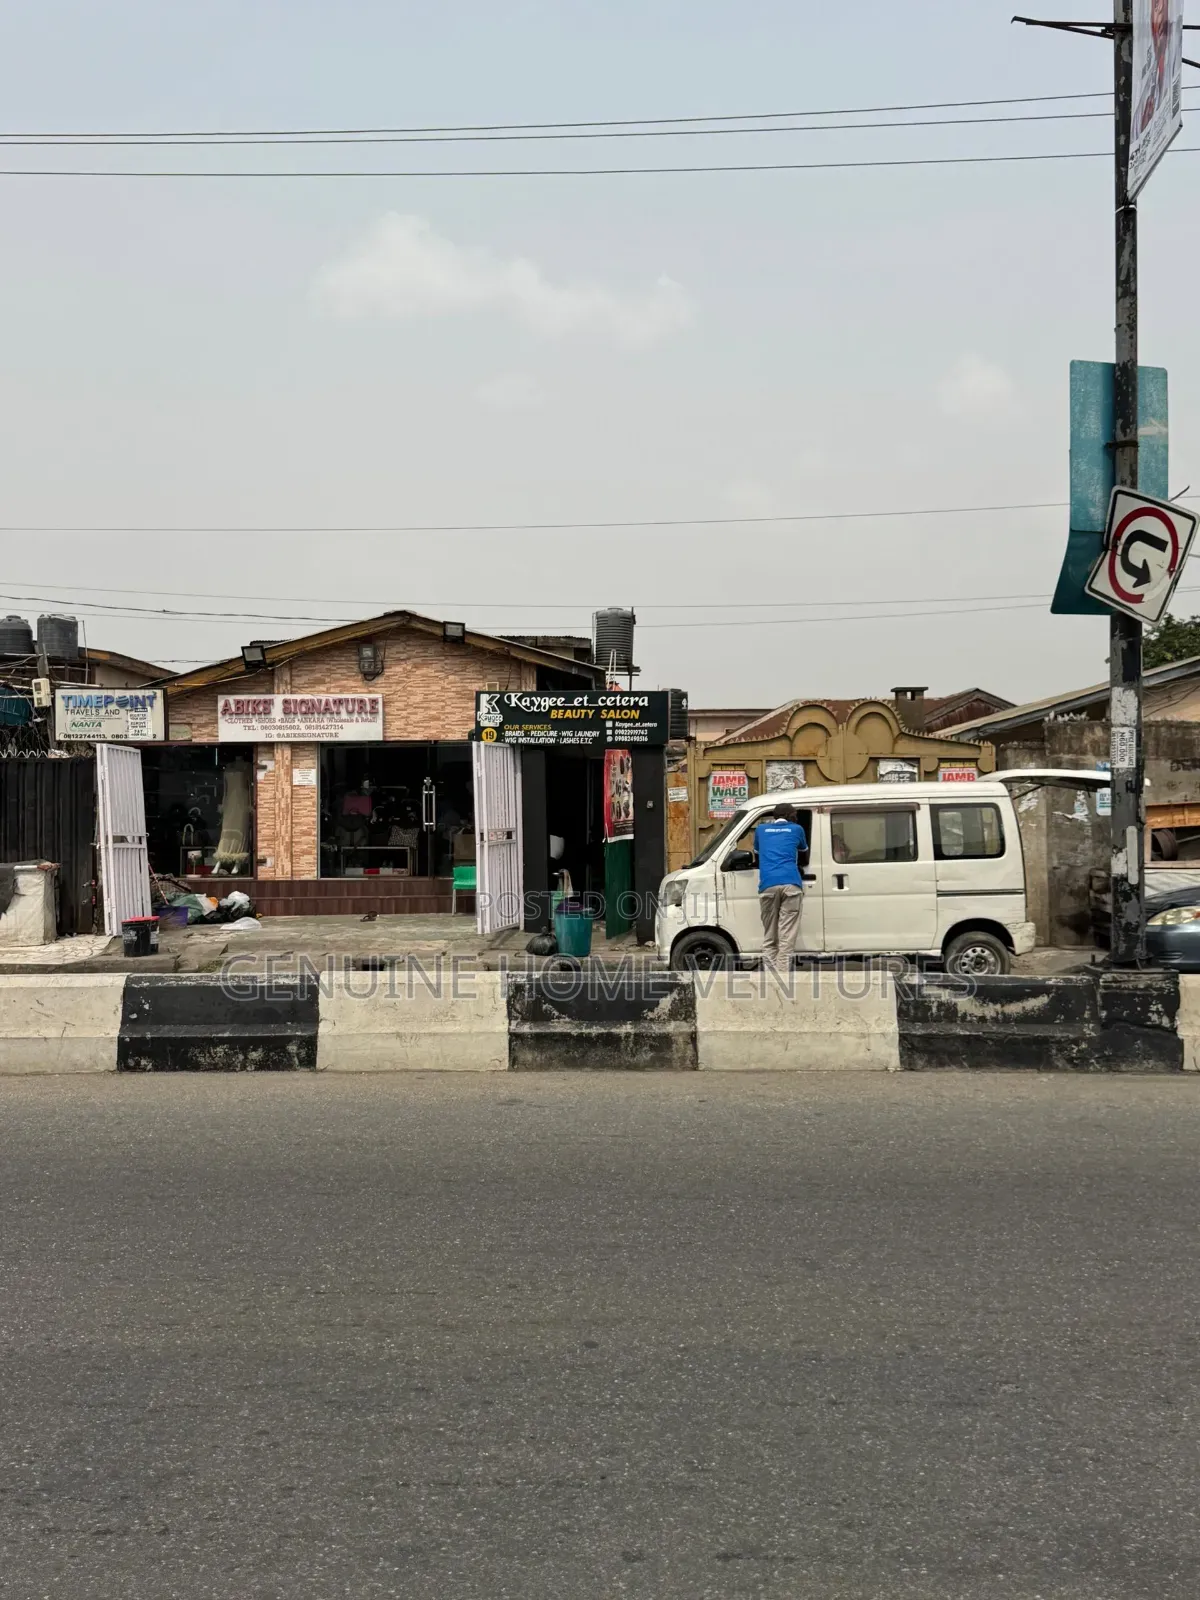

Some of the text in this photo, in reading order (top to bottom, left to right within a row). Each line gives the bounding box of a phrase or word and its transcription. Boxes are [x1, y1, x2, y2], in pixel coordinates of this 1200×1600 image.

[61, 694, 157, 709] TIMEPOINT
[282, 697, 379, 715] SIGNATURE
[504, 692, 649, 712] Kaygee_et_cetera
[550, 709, 640, 719] BEAUTY SALON
[484, 731, 495, 741] 19
[712, 787, 747, 797] WAEC
